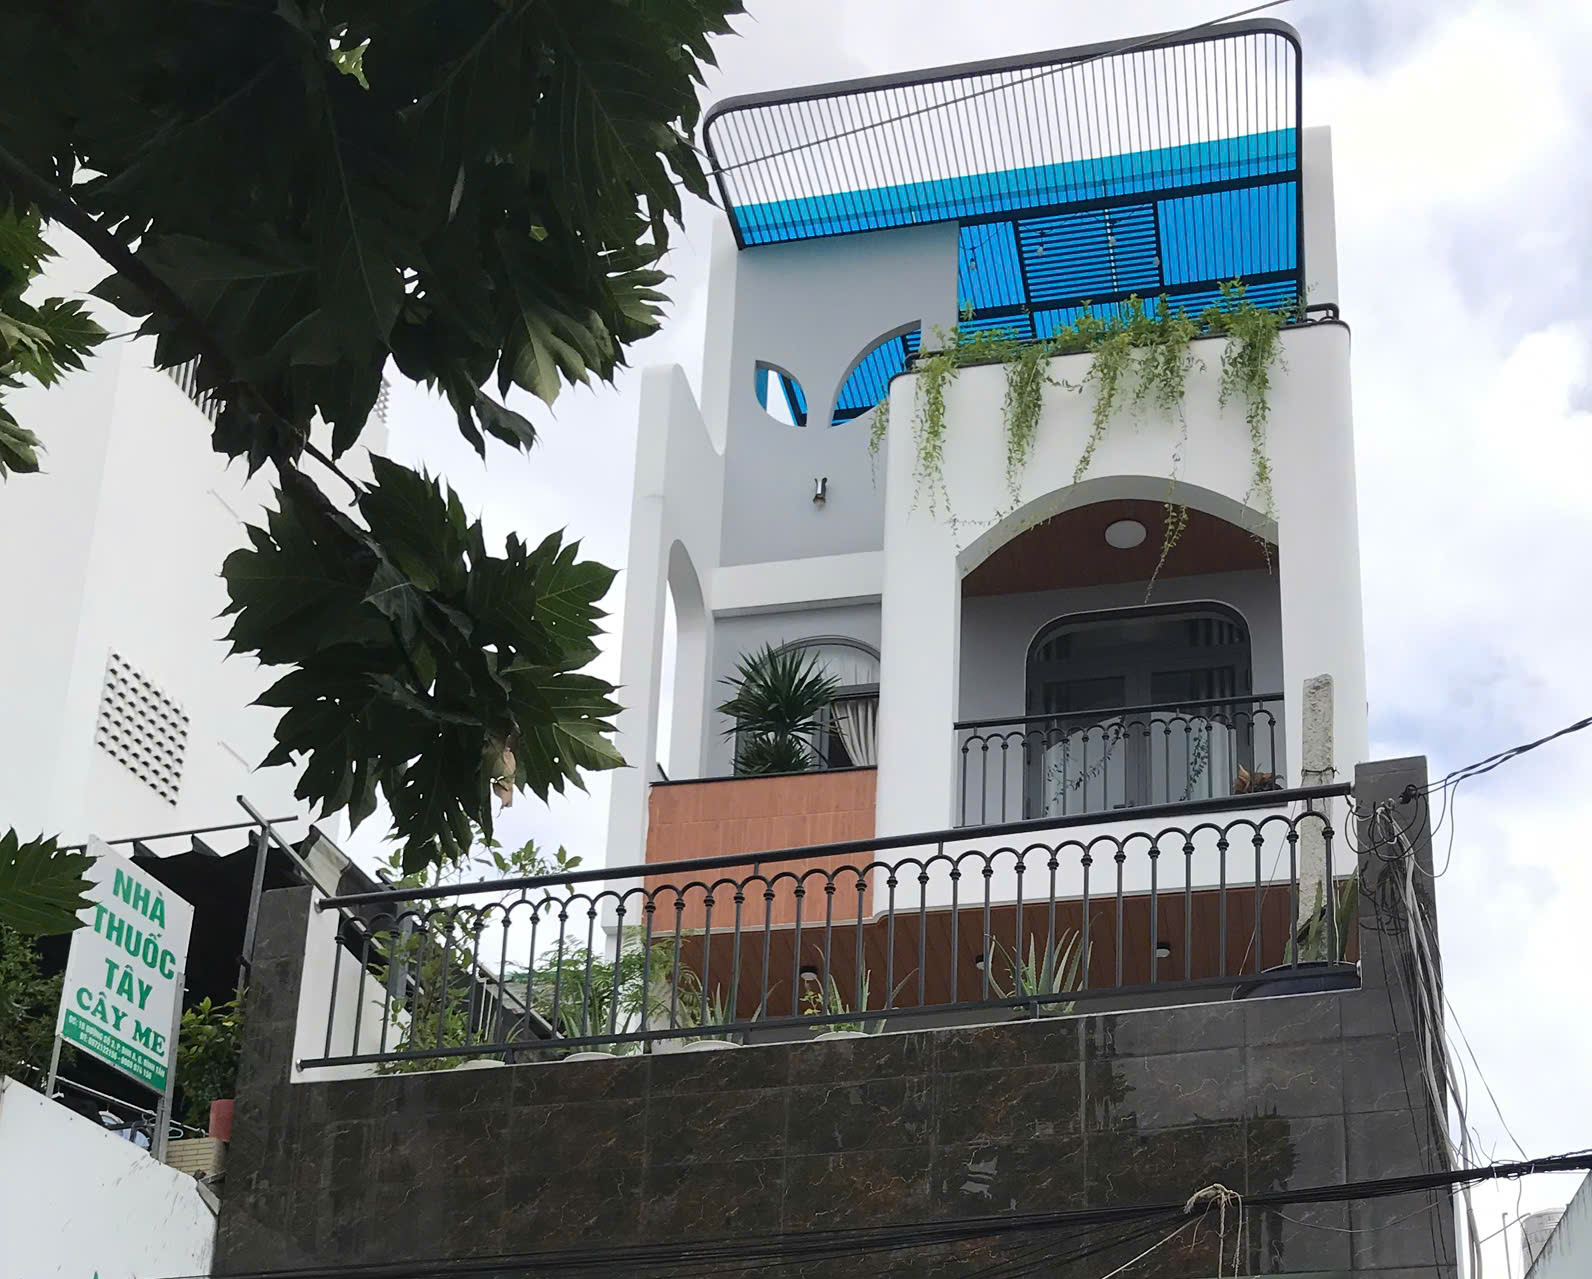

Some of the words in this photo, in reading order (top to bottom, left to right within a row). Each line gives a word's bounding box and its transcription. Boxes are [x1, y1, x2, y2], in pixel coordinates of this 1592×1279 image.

[112, 867, 166, 930] NHÀ
[93, 901, 176, 980] THUỐC
[105, 957, 153, 1011] TÂY
[76, 986, 128, 1032] CÂY
[132, 1018, 166, 1058] ME
